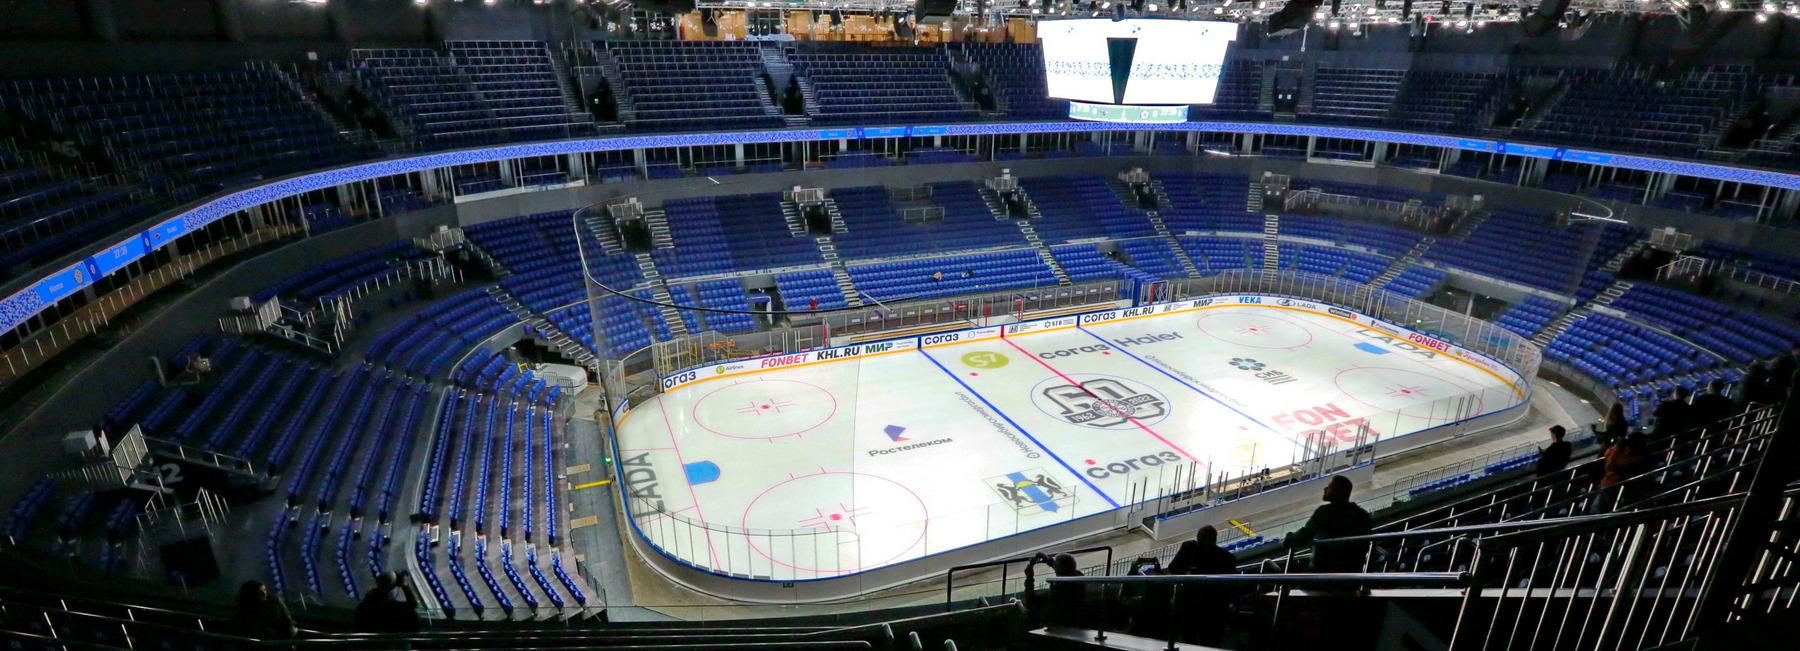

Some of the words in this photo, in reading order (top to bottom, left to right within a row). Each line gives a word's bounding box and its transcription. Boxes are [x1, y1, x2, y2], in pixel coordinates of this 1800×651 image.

[1238, 296, 1262, 304] VEKA
[1297, 302, 1317, 310] LADA
[1084, 311, 1116, 324] согаз
[1122, 306, 1155, 318] KHL.RU
[924, 333, 959, 345] согаз
[1114, 331, 1184, 348] Haier
[1355, 328, 1438, 359] LADA
[1408, 332, 1451, 353] FONBET
[817, 348, 860, 361] KHL.RU
[1038, 343, 1111, 360] согаз
[761, 353, 809, 369] FONBET
[1071, 411, 1097, 423] 1962
[1271, 402, 1351, 431] FON
[868, 436, 953, 457] Ростелеком
[1086, 450, 1182, 479] согаз
[622, 451, 666, 519] LADA
